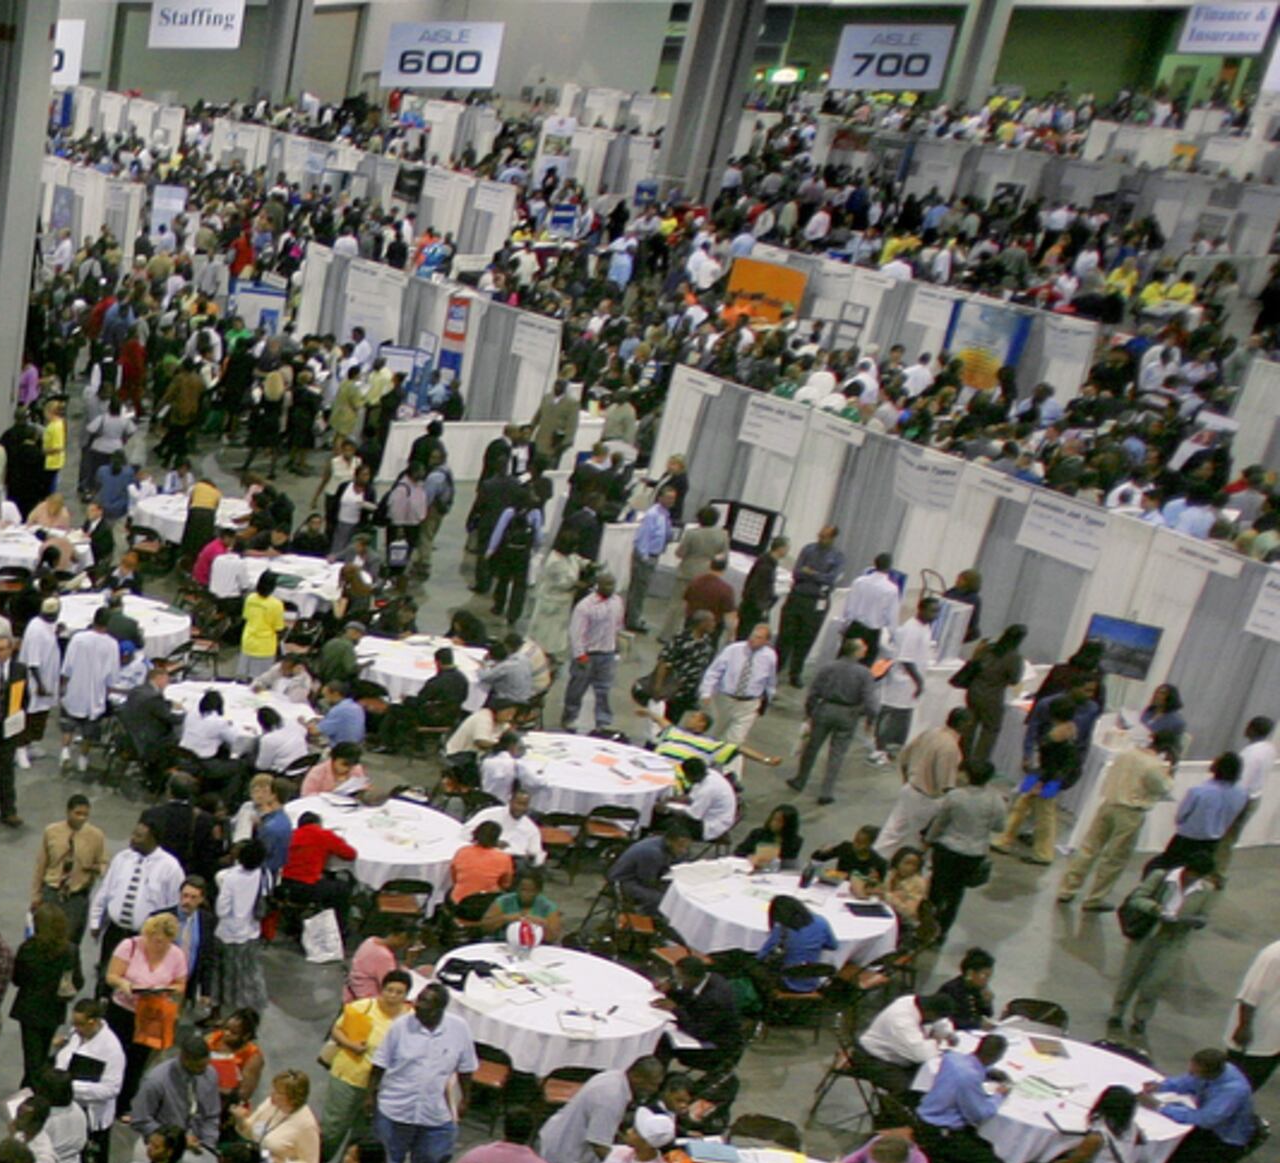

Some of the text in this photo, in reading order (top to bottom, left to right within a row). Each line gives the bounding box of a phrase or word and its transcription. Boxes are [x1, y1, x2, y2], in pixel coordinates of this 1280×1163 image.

[158, 7, 236, 30] Staffing
[418, 28, 473, 44] AISLE
[398, 50, 483, 75] 600
[852, 53, 932, 77] 700
